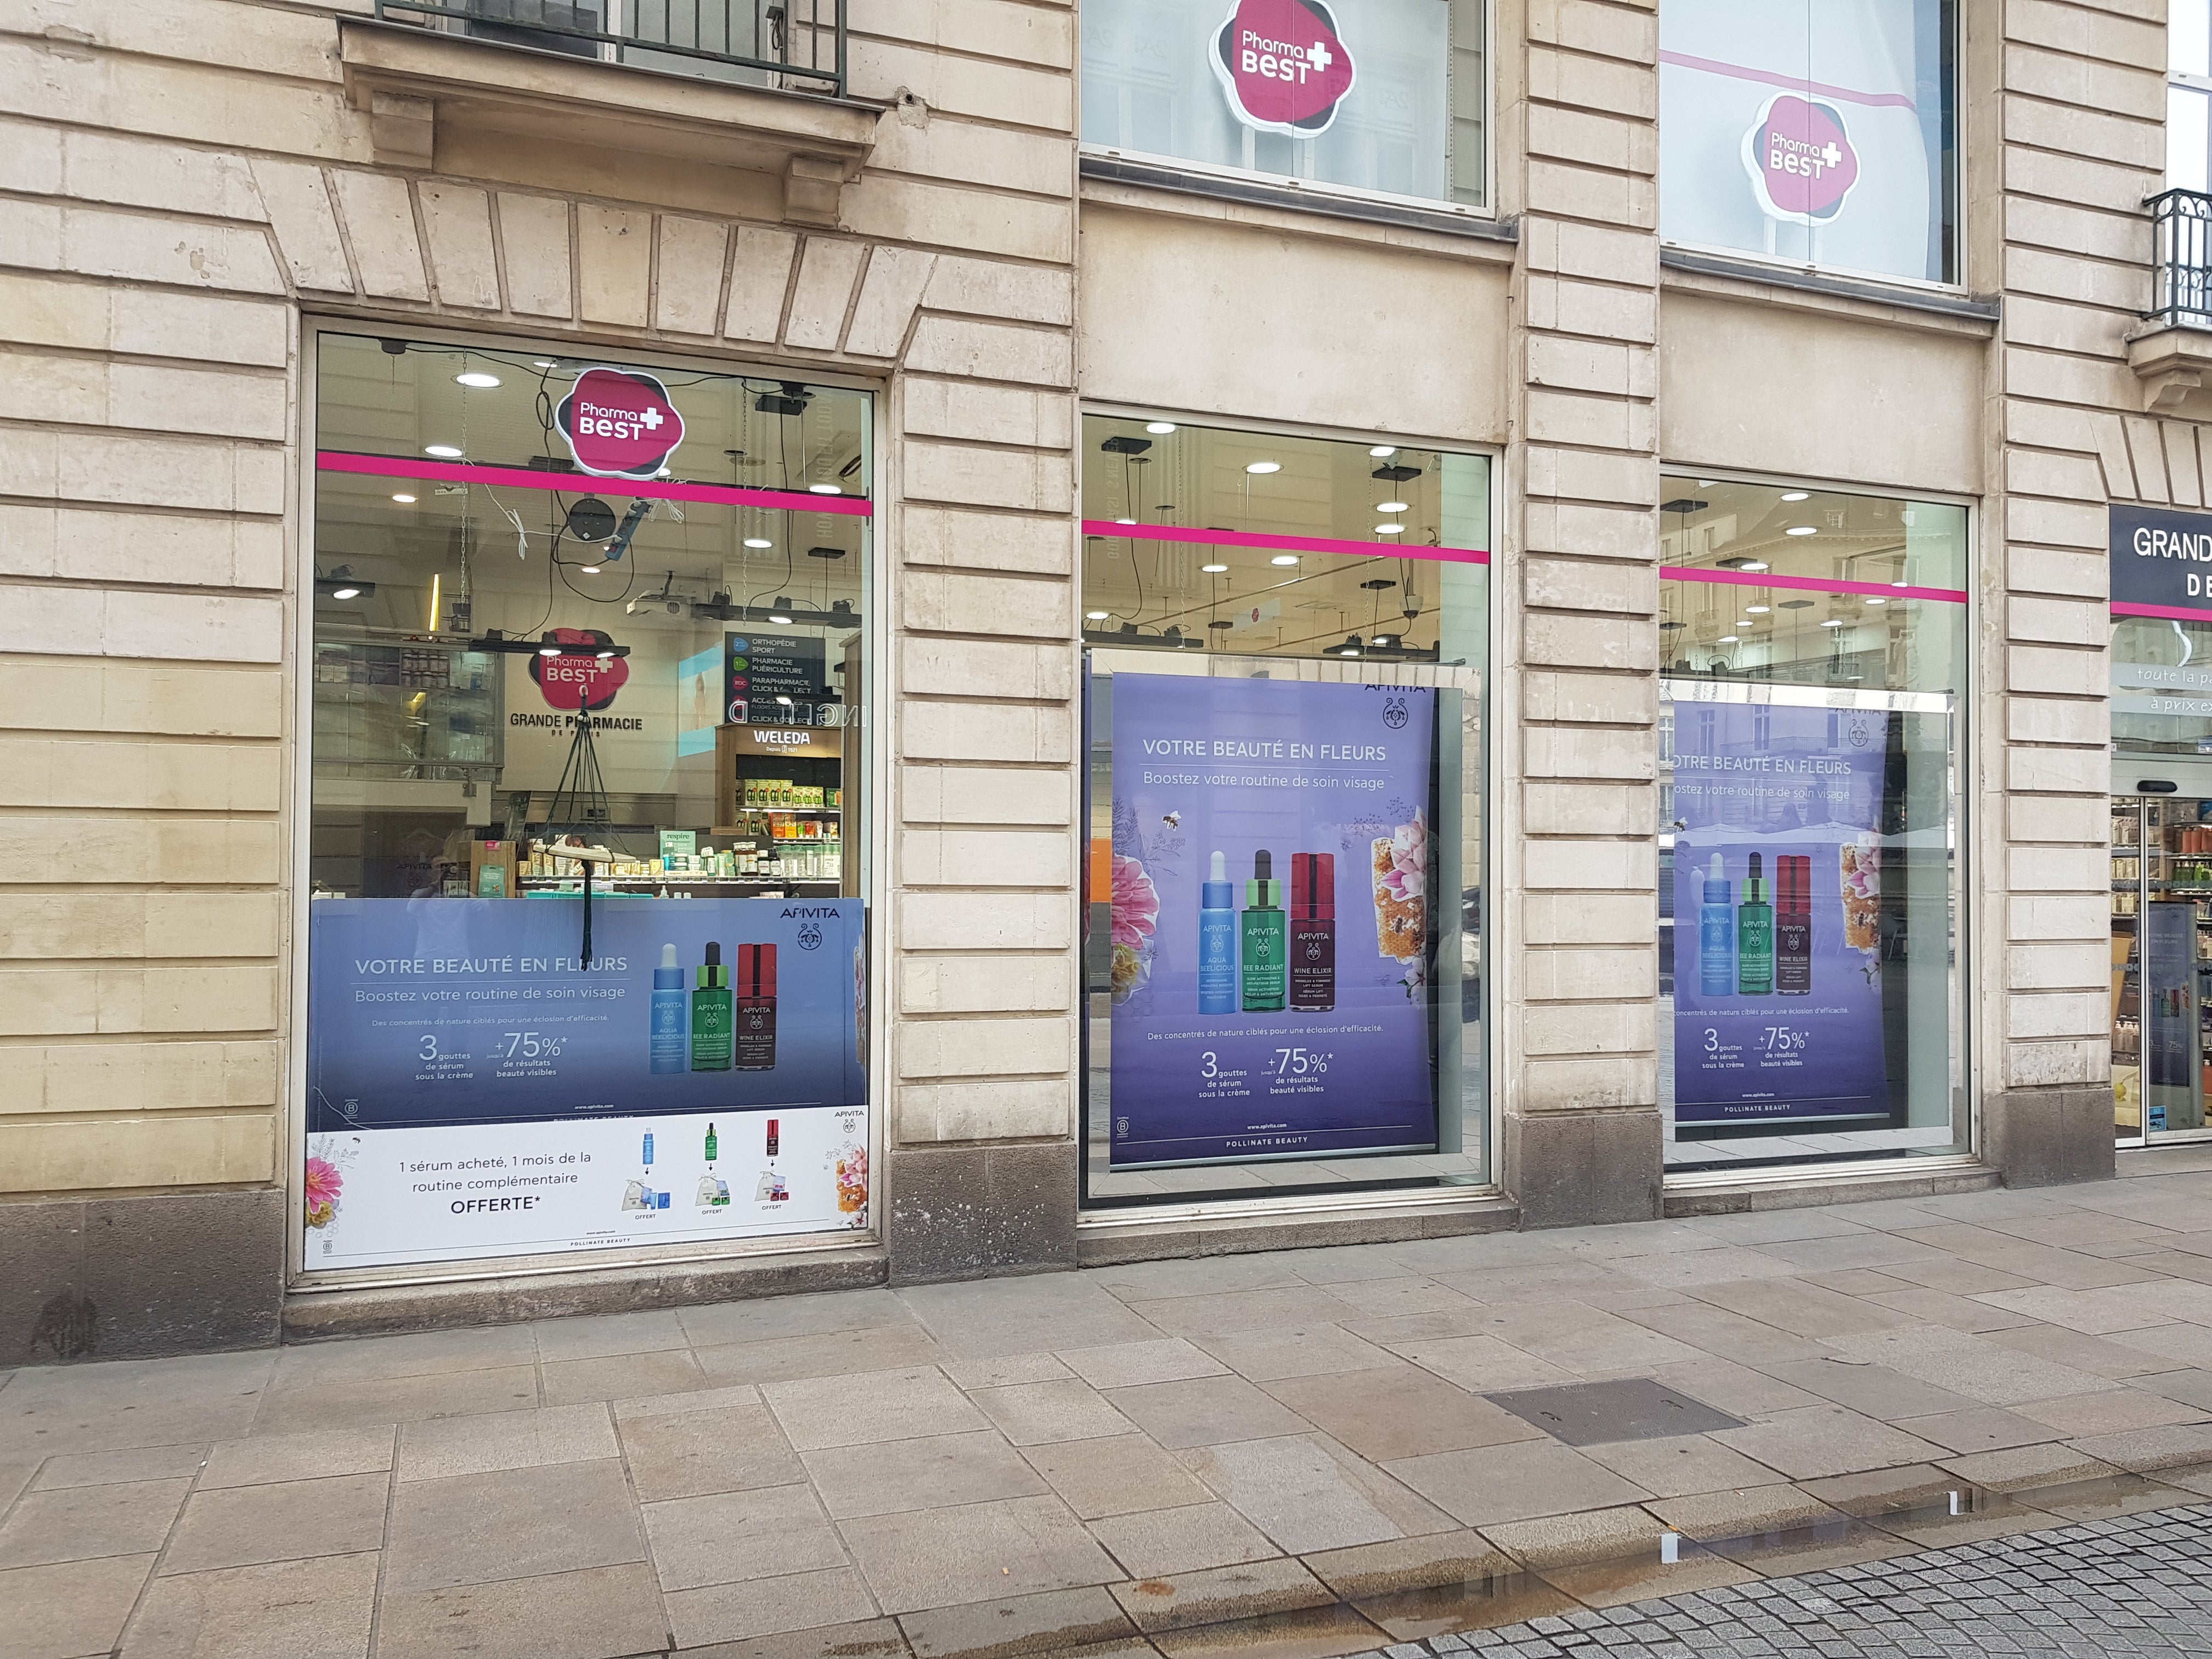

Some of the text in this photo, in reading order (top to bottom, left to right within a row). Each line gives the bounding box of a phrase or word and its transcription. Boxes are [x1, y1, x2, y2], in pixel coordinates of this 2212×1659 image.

[1243, 30, 1304, 59] Pharma
[1771, 132, 1820, 157] Pharma
[580, 402, 637, 421] Pharma
[2134, 527, 2212, 562] GRAND
[752, 638, 797, 647] ORTHOPÉDIE
[546, 656, 592, 668] Pharma
[752, 657, 793, 665] PHARMACIE
[752, 665, 803, 674] PUÉRICULTURE
[2137, 668, 2194, 682] toute la
[2151, 697, 2195, 712] à prix
[511, 713, 561, 727] GRANDE
[754, 730, 810, 744] WELEDA
[1142, 738, 1386, 761] VOTRE BEAUTÉ EN FLEURS
[1714, 756, 1852, 775] BEAUTÉ EN FLEURS
[1143, 771, 1384, 792] Boostez votre routine de soin visage
[1706, 786, 1850, 802] votre routine de soin visage
[780, 908, 840, 918] APIVITA
[1247, 928, 1279, 936] APIVITA
[355, 960, 425, 974] VOTRE
[433, 956, 514, 973] BEAUTÉ
[521, 958, 548, 972] EN
[355, 986, 625, 1002] Boostez votre routine de soin visage
[389, 1017, 432, 1026] concentrés
[473, 1015, 495, 1024] ciblés
[498, 1017, 516, 1025] pour
[533, 1014, 565, 1023] éclosion
[1760, 1009, 1775, 1017] pour
[1165, 1030, 1205, 1040] concentrés
[1207, 1029, 1217, 1037] de
[1220, 1029, 1244, 1037] nature
[1246, 1028, 1267, 1036] ciblés
[1270, 1028, 1288, 1036] pour
[1306, 1026, 1338, 1035] éclosion
[1703, 1028, 1719, 1051] 3
[419, 1035, 471, 1061] 3 gouttes
[516, 1059, 551, 1067] résultats
[1201, 1051, 1247, 1079] 3 gouttes
[448, 1071, 473, 1079] crème
[496, 1068, 557, 1078] beauté visibles
[1287, 1075, 1318, 1084] résultats
[1207, 1079, 1242, 1088] de sérum
[1270, 1085, 1324, 1094] beauté visibles
[1227, 1088, 1250, 1096] crème
[1226, 1138, 1271, 1147] POLLINATE
[399, 1151, 591, 1172] 1 sérum acheté, 1 mois de la
[413, 1173, 578, 1192] routine complémentaire
